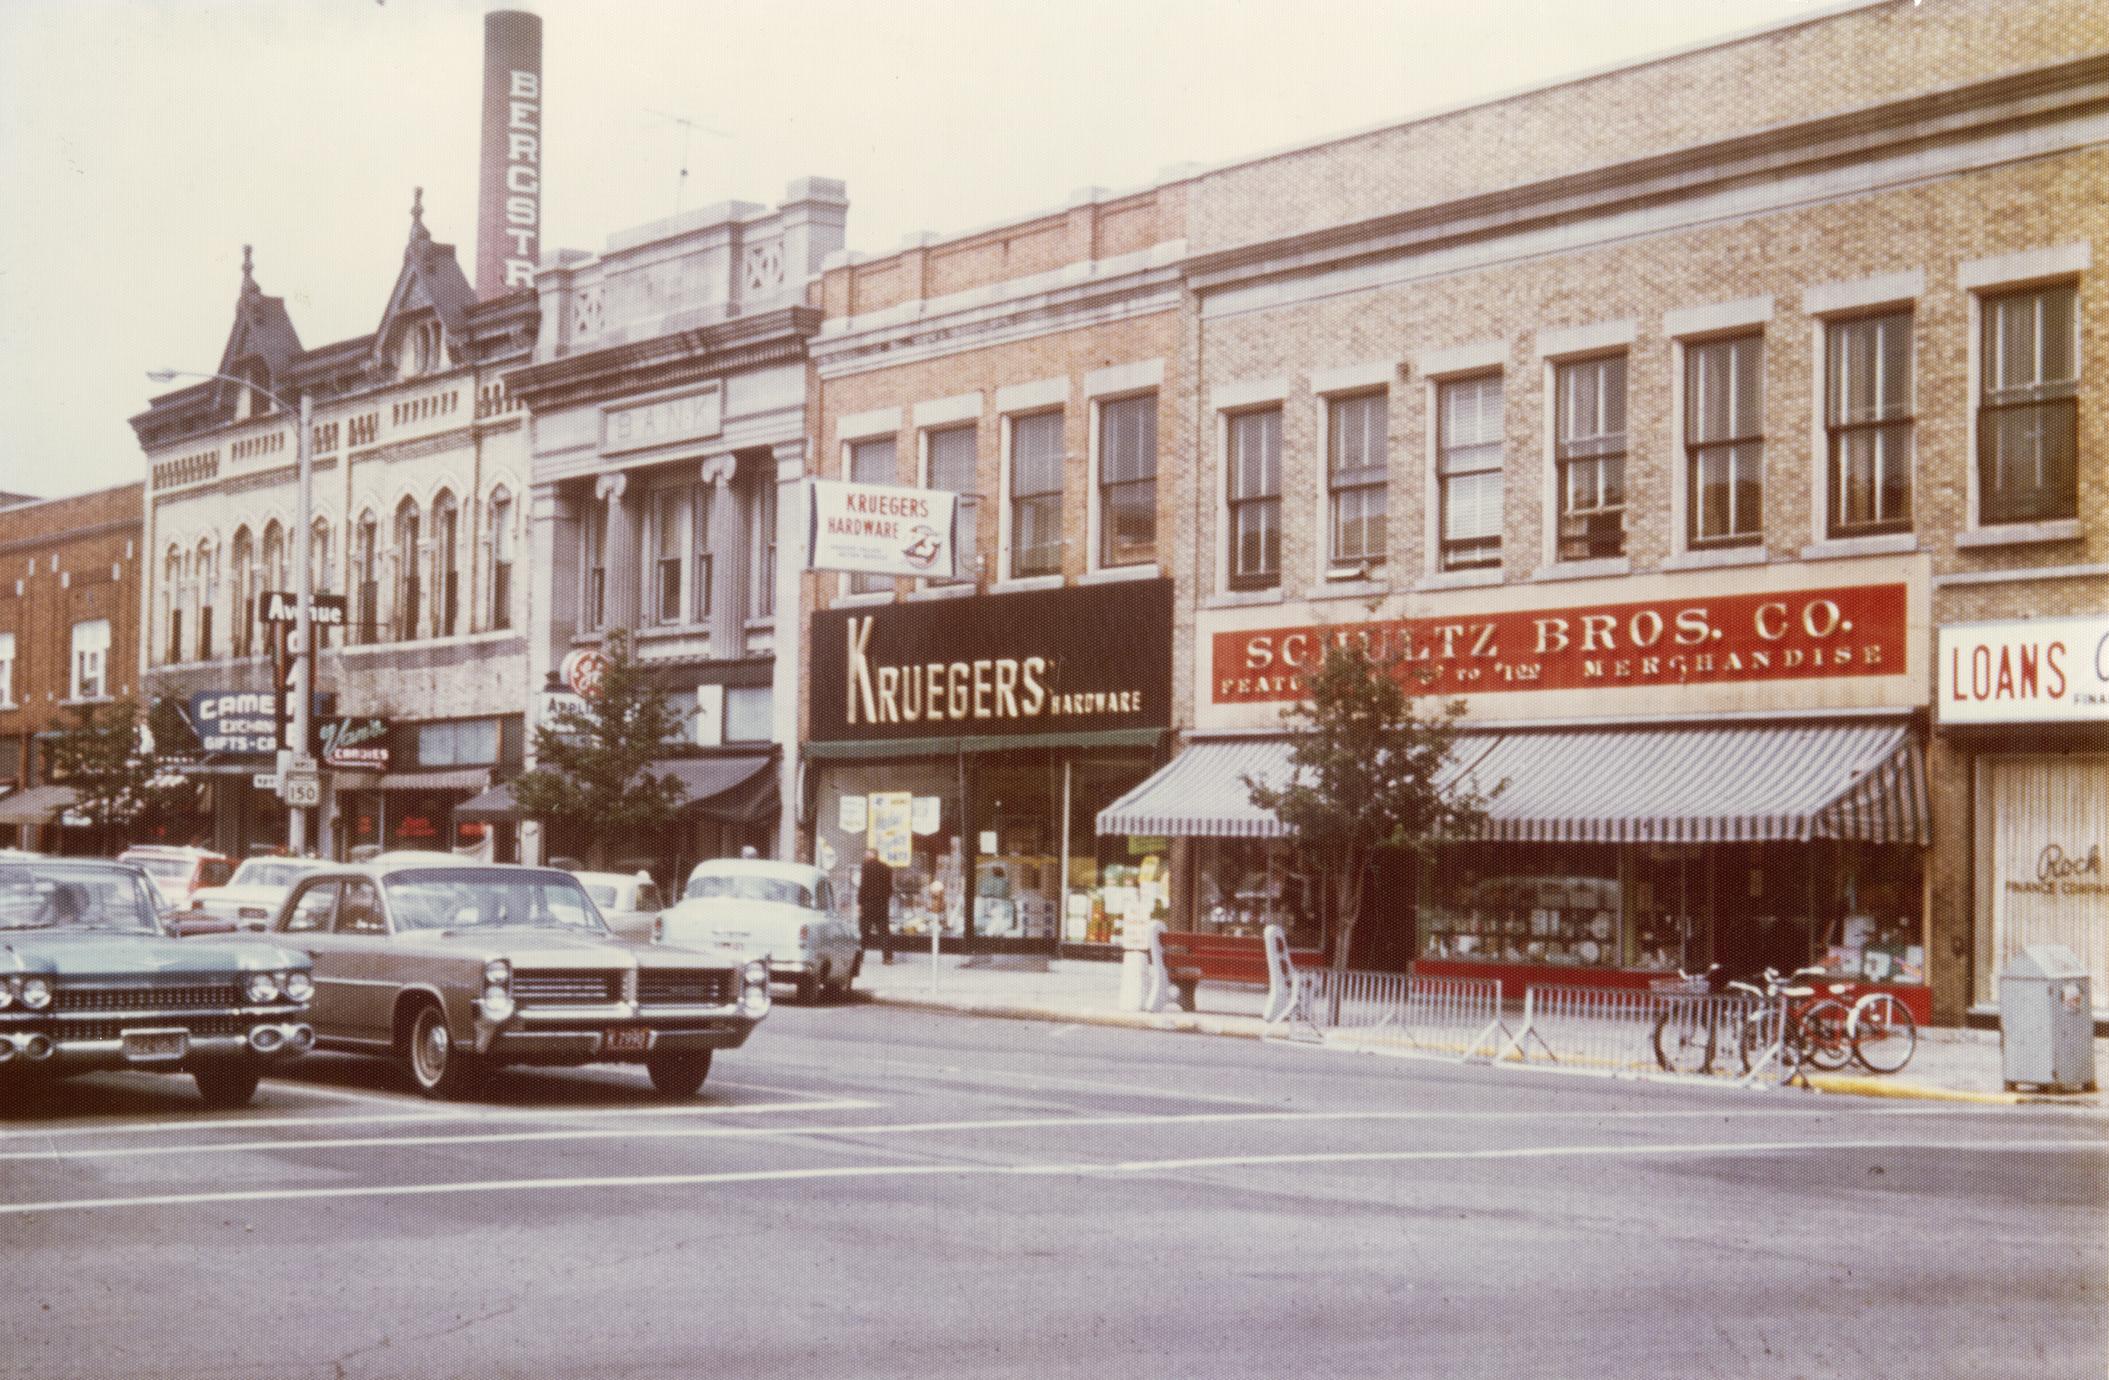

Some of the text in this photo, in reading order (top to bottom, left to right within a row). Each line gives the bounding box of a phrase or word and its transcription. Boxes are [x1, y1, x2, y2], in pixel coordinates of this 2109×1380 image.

[617, 396, 708, 440] BANK
[846, 492, 930, 519] KRUEGERS
[827, 516, 900, 539] HARDWARE
[268, 592, 343, 618] Avnue
[1533, 607, 1724, 654] BROS.
[1754, 599, 1853, 641] CO.
[1584, 644, 1882, 678] MERCHANDISE
[1953, 641, 2067, 701] LOANS
[199, 694, 276, 720] CAME
[1050, 690, 1142, 717] HARDWARE
[290, 785, 316, 802] 150
